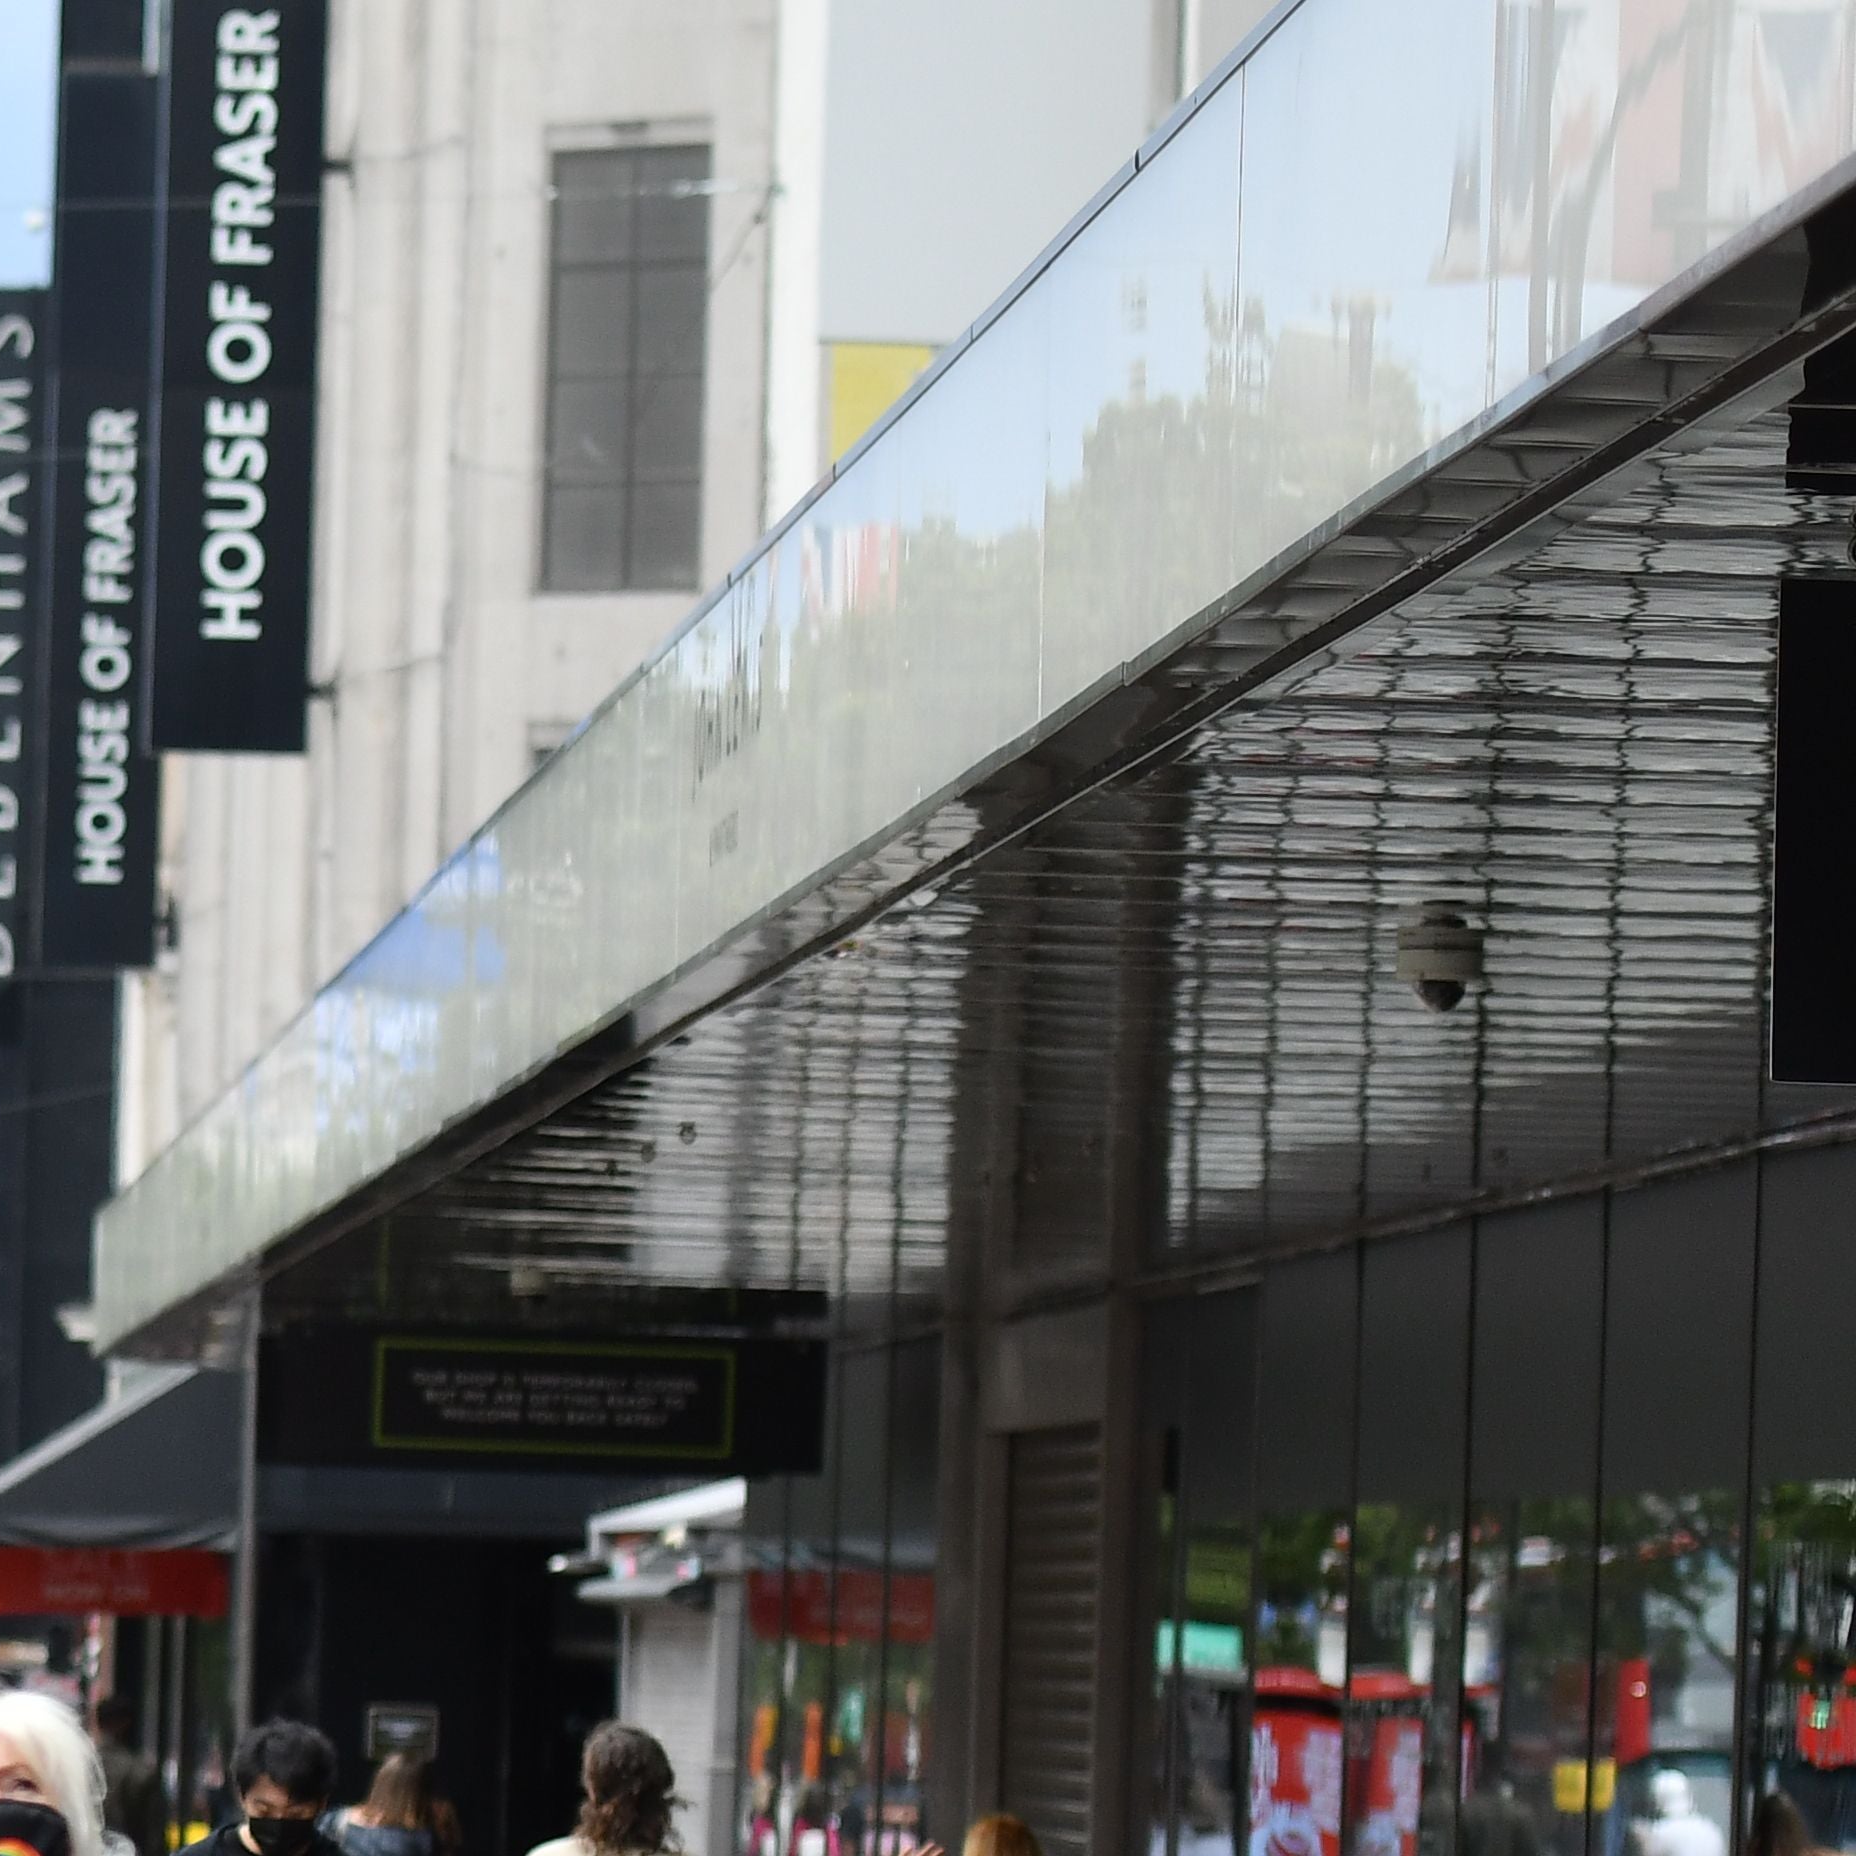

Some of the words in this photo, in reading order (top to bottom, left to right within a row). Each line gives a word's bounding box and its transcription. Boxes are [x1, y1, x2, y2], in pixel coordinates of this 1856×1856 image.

[209, 8, 282, 265] FRASER
[207, 280, 272, 384] OF
[83, 407, 139, 603] FRASER
[200, 396, 269, 640] HOUSE
[80, 612, 131, 692] OF
[75, 699, 128, 885] HOUSE
